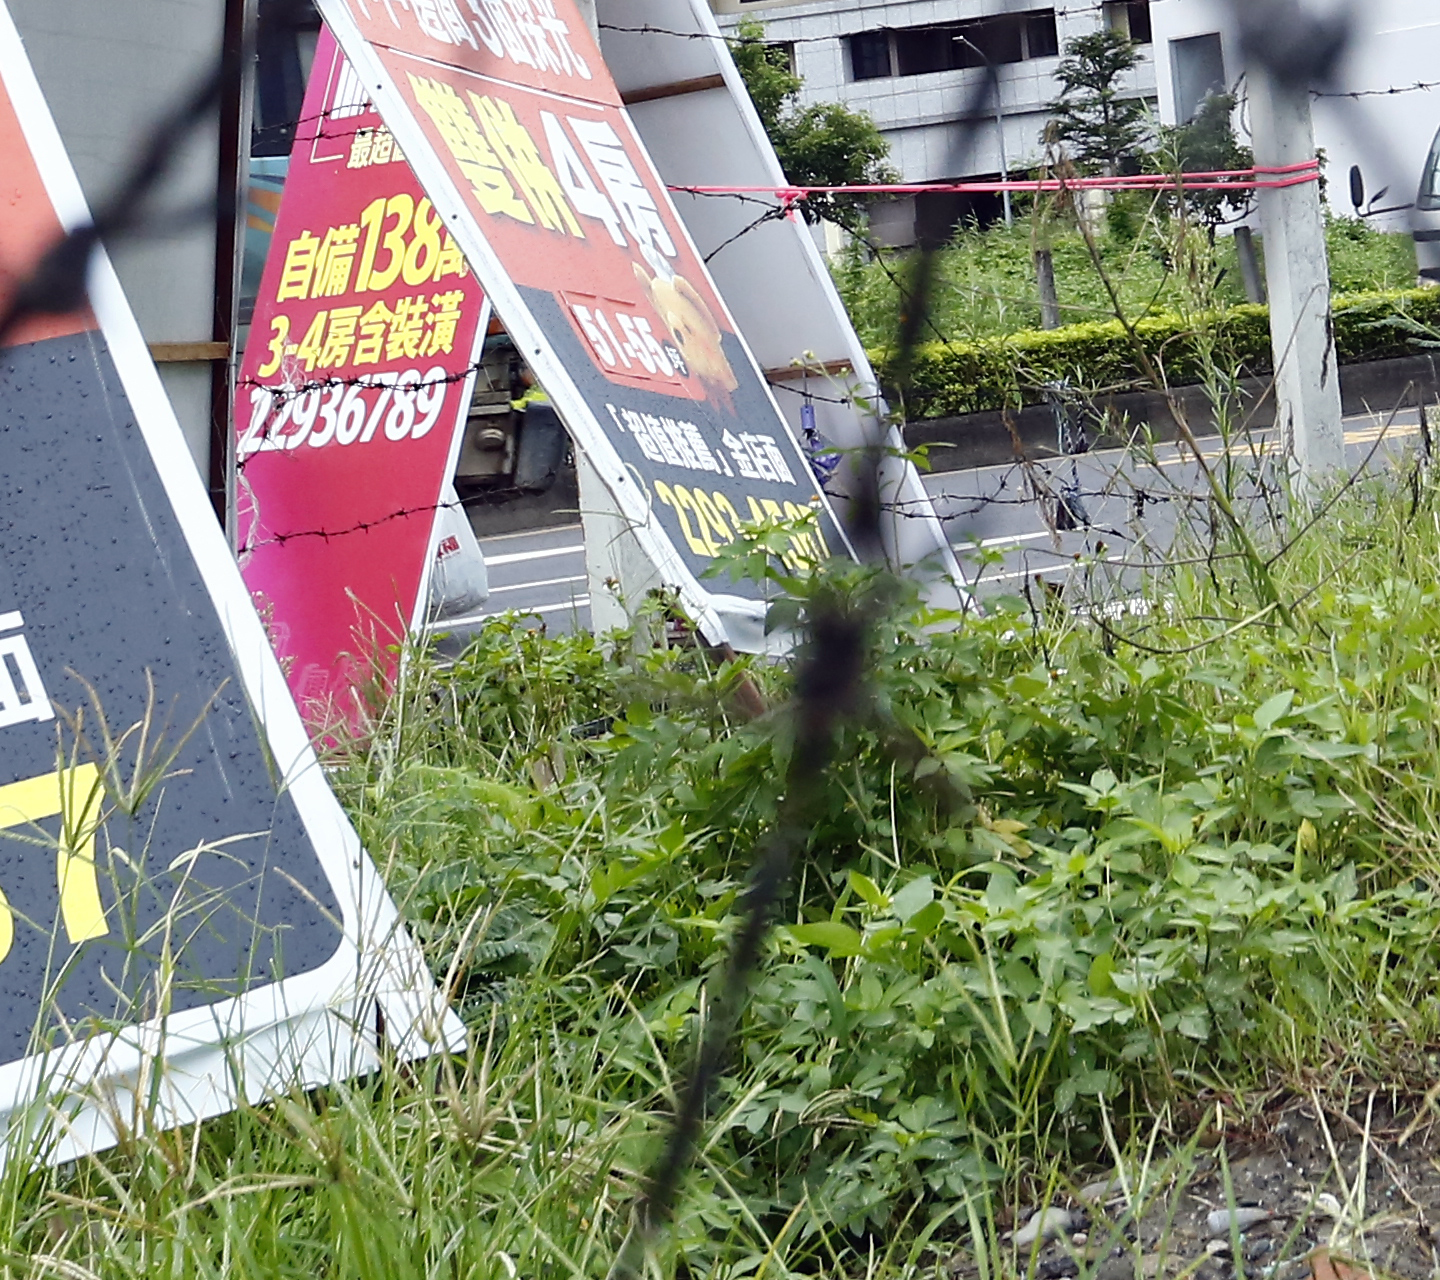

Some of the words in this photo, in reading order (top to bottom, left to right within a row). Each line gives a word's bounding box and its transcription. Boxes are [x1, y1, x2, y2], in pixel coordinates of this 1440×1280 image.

[257, 290, 465, 378] 3-4房含裝潢
[572, 304, 675, 377] 51-55
[236, 366, 448, 453] 22936789
